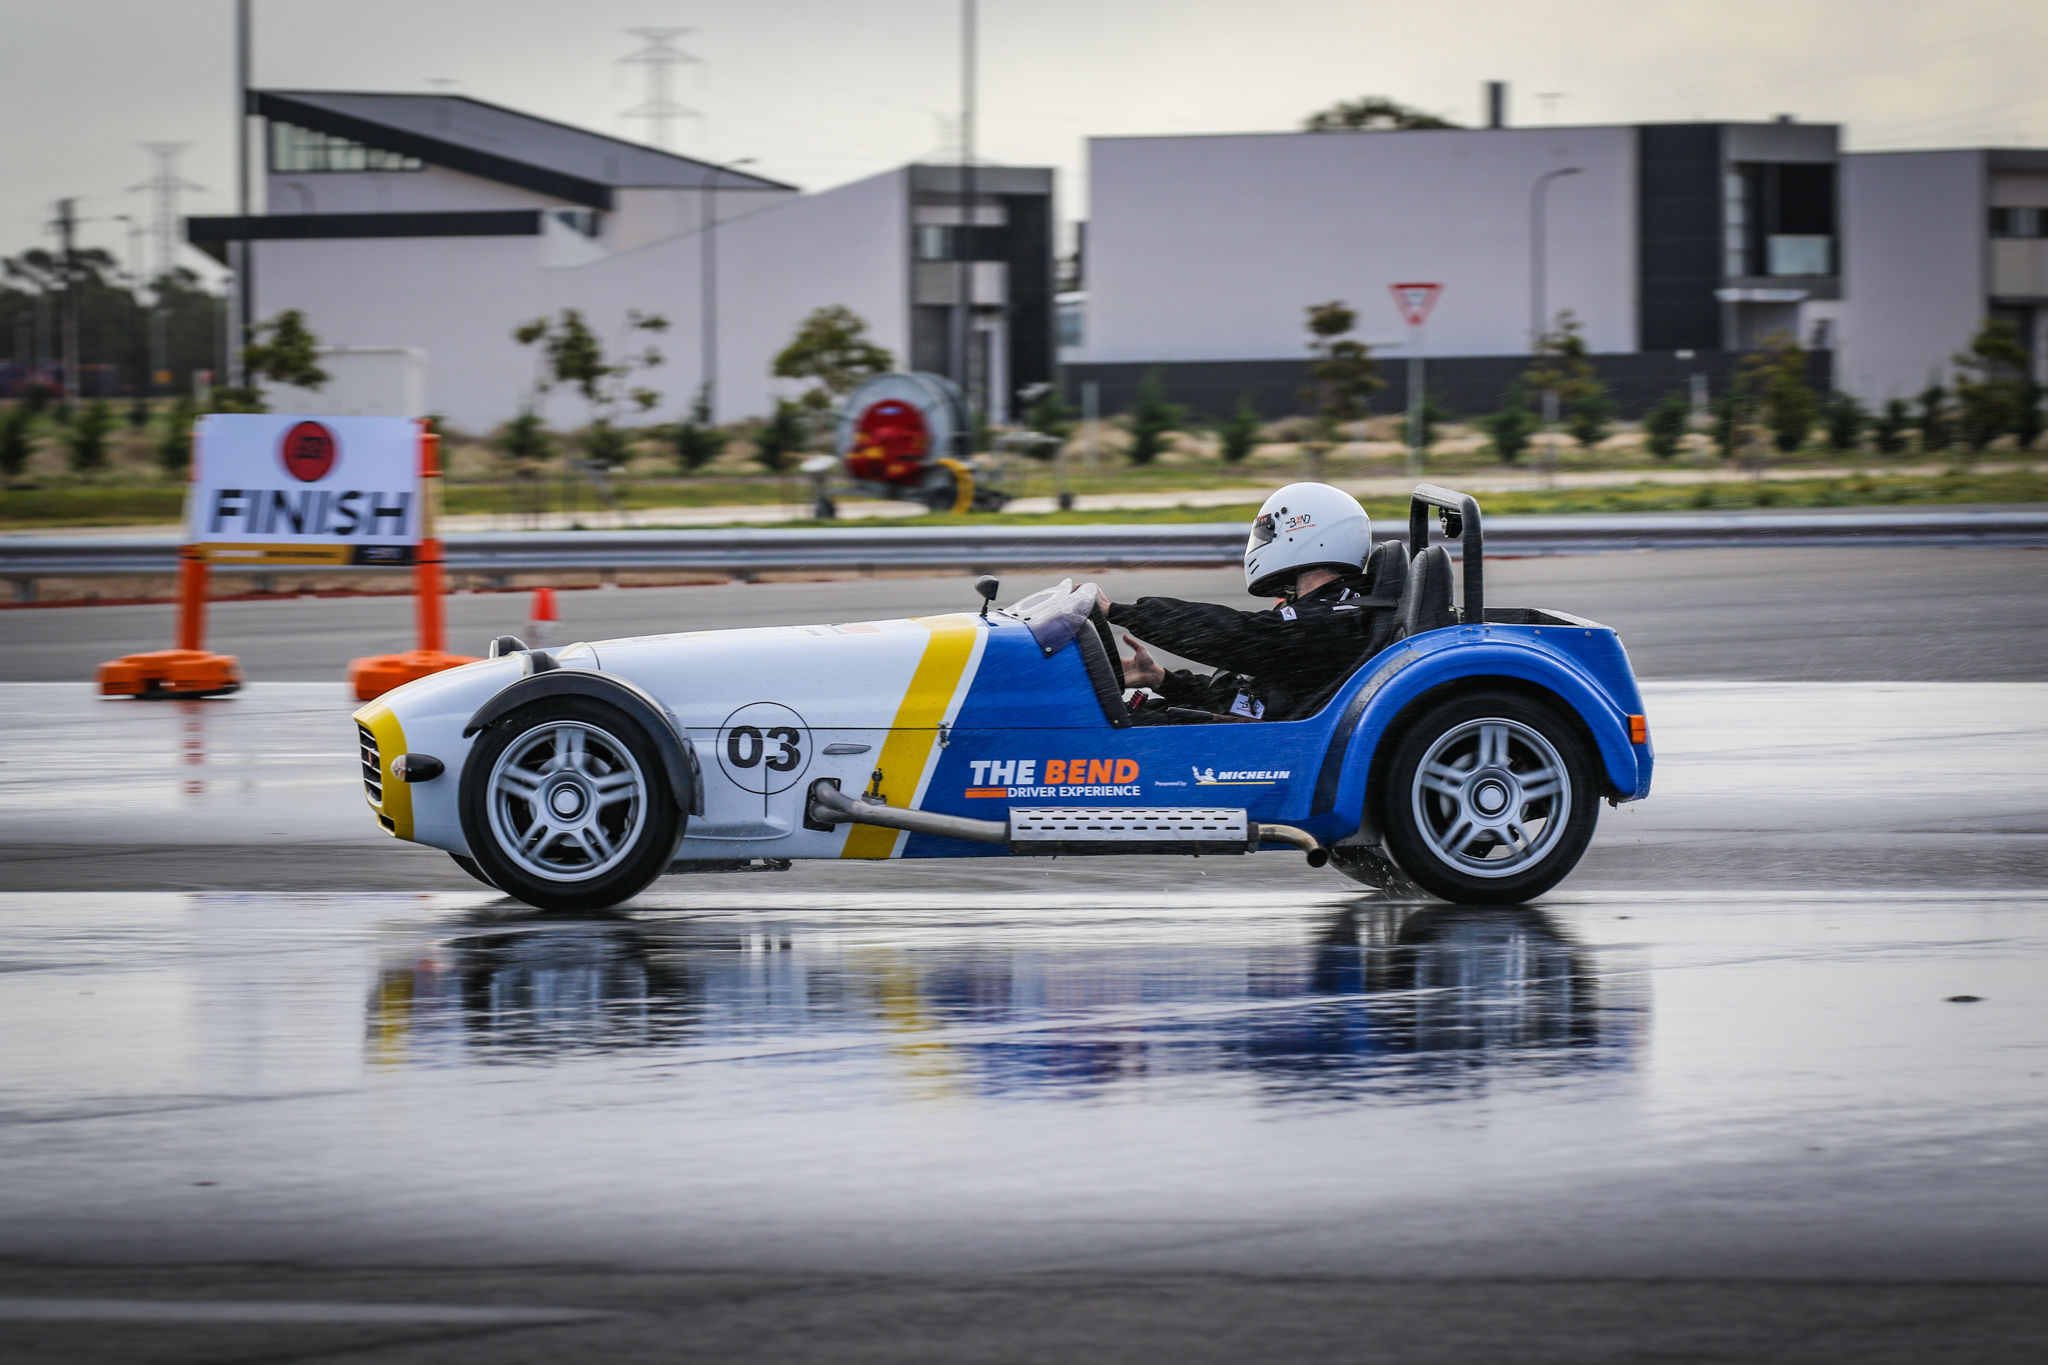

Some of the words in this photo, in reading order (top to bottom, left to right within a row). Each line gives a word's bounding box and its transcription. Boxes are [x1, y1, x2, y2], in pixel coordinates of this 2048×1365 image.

[209, 489, 415, 535] FINISH
[728, 725, 801, 771] 03
[970, 760, 1036, 785] THE
[1044, 759, 1139, 784] BEND
[1218, 771, 1290, 780] MICHELIN
[1008, 787, 1057, 798] DRIVER
[1059, 786, 1141, 797] EXPERIENCE
